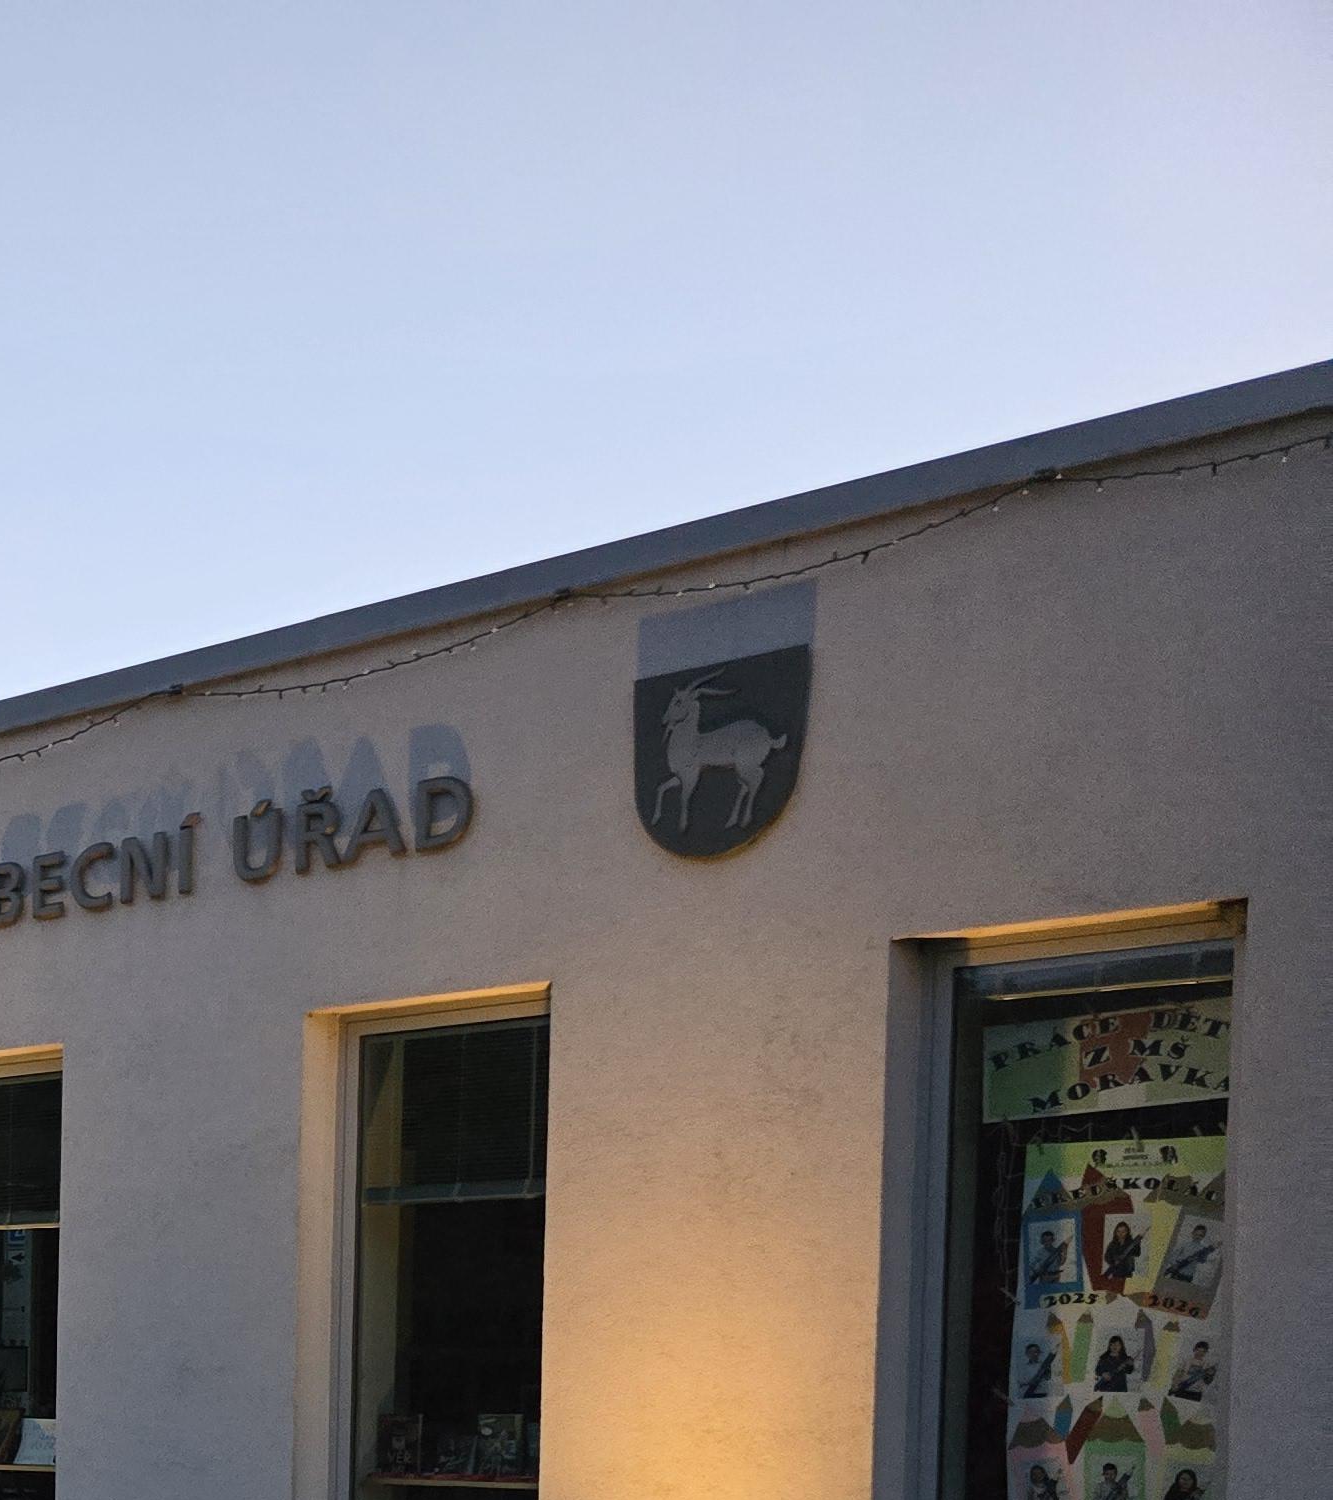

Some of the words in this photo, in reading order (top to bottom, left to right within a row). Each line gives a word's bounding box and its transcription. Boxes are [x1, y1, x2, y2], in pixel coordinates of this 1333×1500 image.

[233, 775, 476, 884] ÚŘAD
[1084, 1046, 1110, 1068] Z
[1129, 1036, 1193, 1061] MŠ
[1044, 1293, 1100, 1308] 2025
